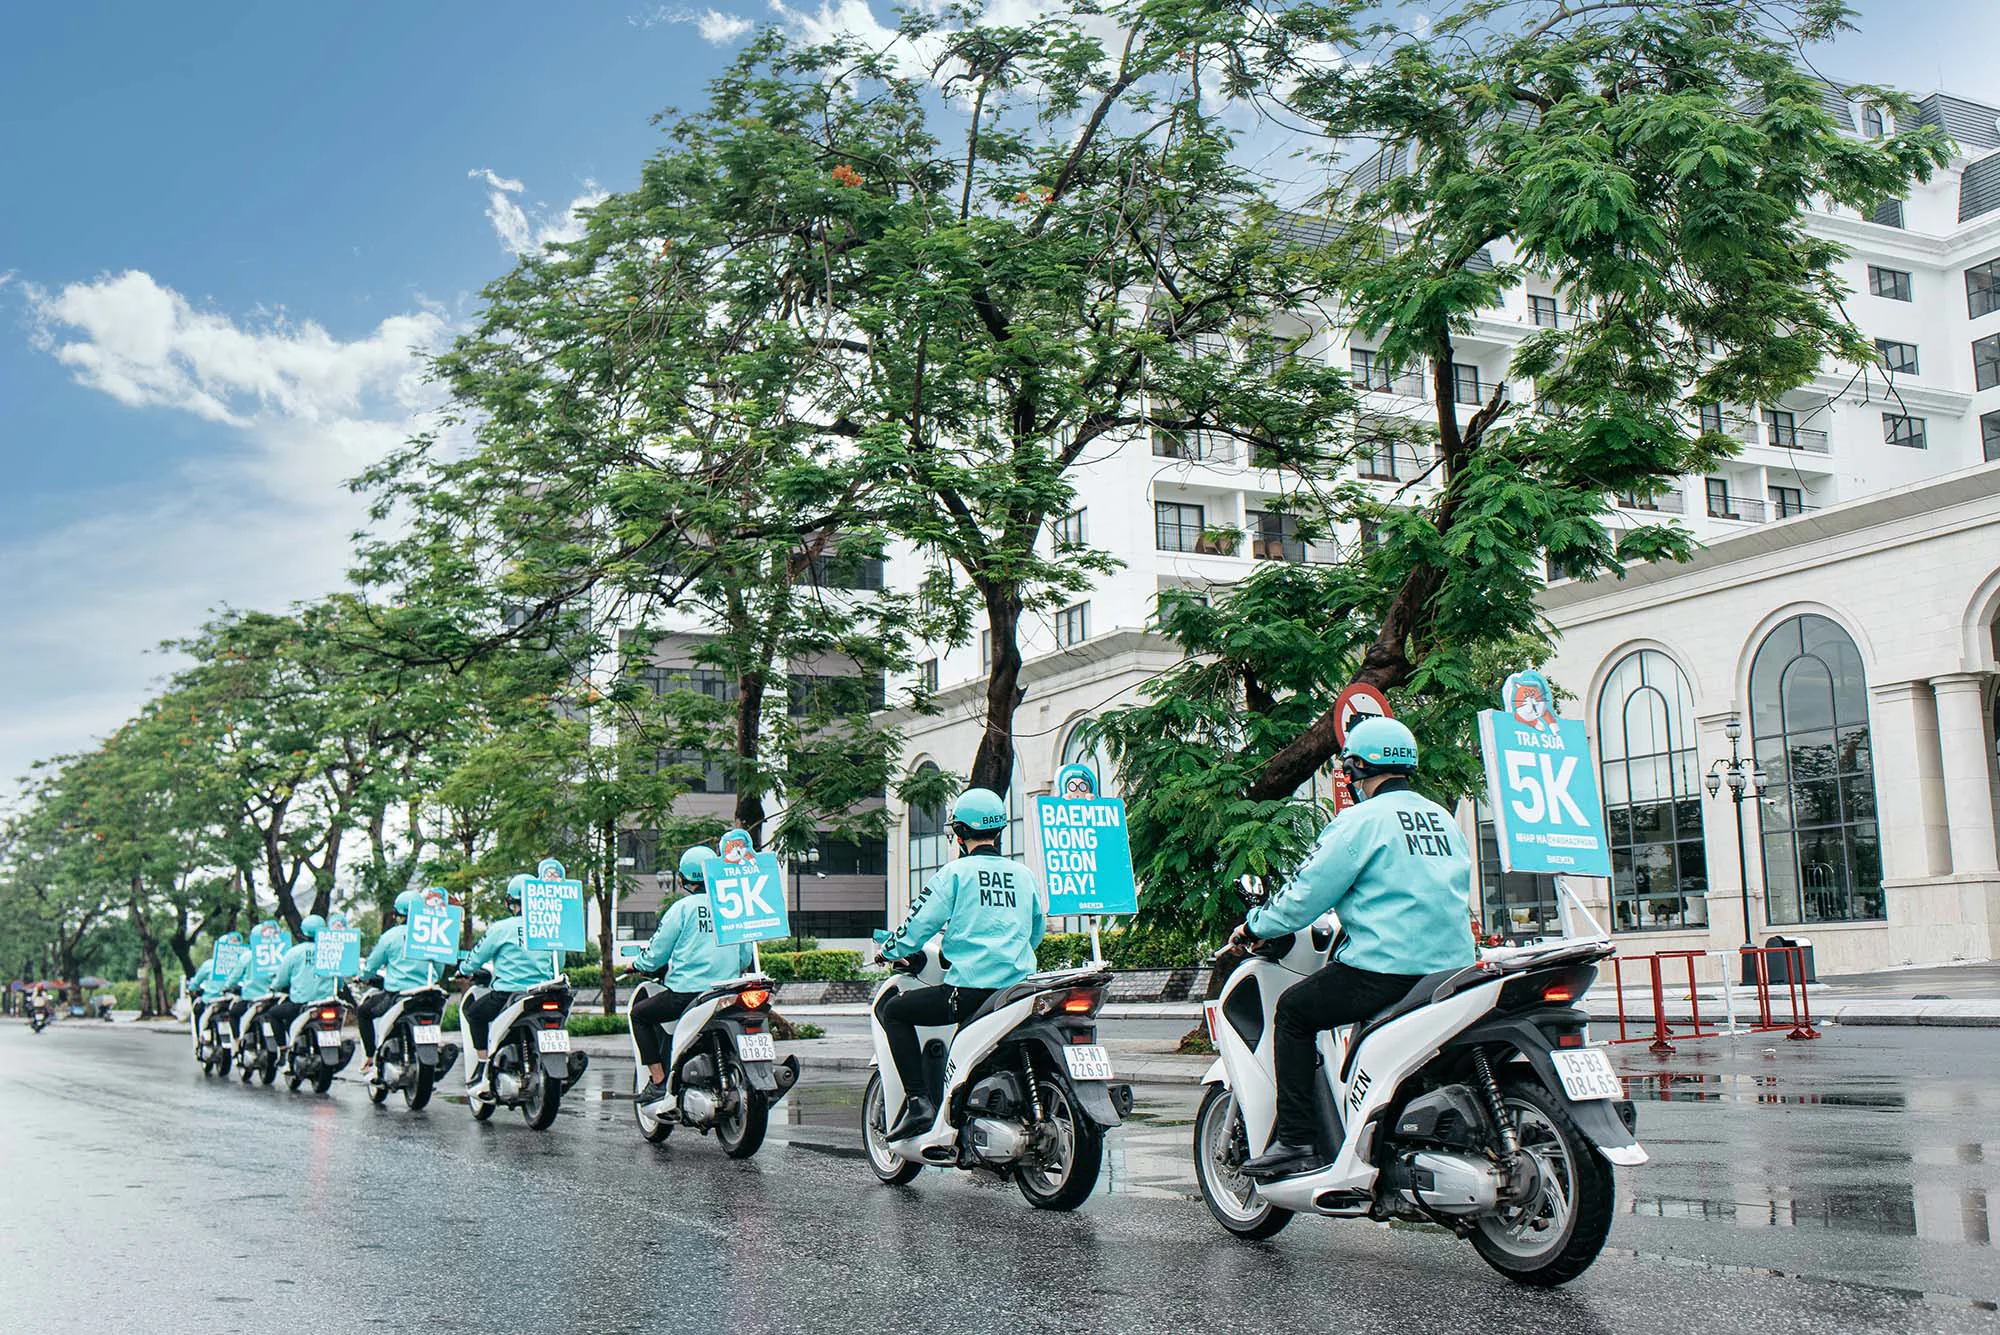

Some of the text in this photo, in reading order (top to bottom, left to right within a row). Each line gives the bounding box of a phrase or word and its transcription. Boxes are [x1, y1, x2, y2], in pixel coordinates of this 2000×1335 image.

[1504, 749, 1591, 827] 5K
[1041, 804, 1120, 827] BAEMIN
[1396, 811, 1444, 832] BAE
[1405, 834, 1452, 856] MIN
[527, 883, 578, 899] BAEMIN
[978, 871, 1015, 889] BAE
[715, 874, 776, 919] 5K
[980, 889, 1017, 908] MIN
[412, 915, 454, 946] 5K
[255, 943, 286, 966] 5K
[1071, 1063, 1110, 1077] 226.97
[1349, 1068, 1372, 1112] MIN
[1566, 1074, 1619, 1096] 084.65
